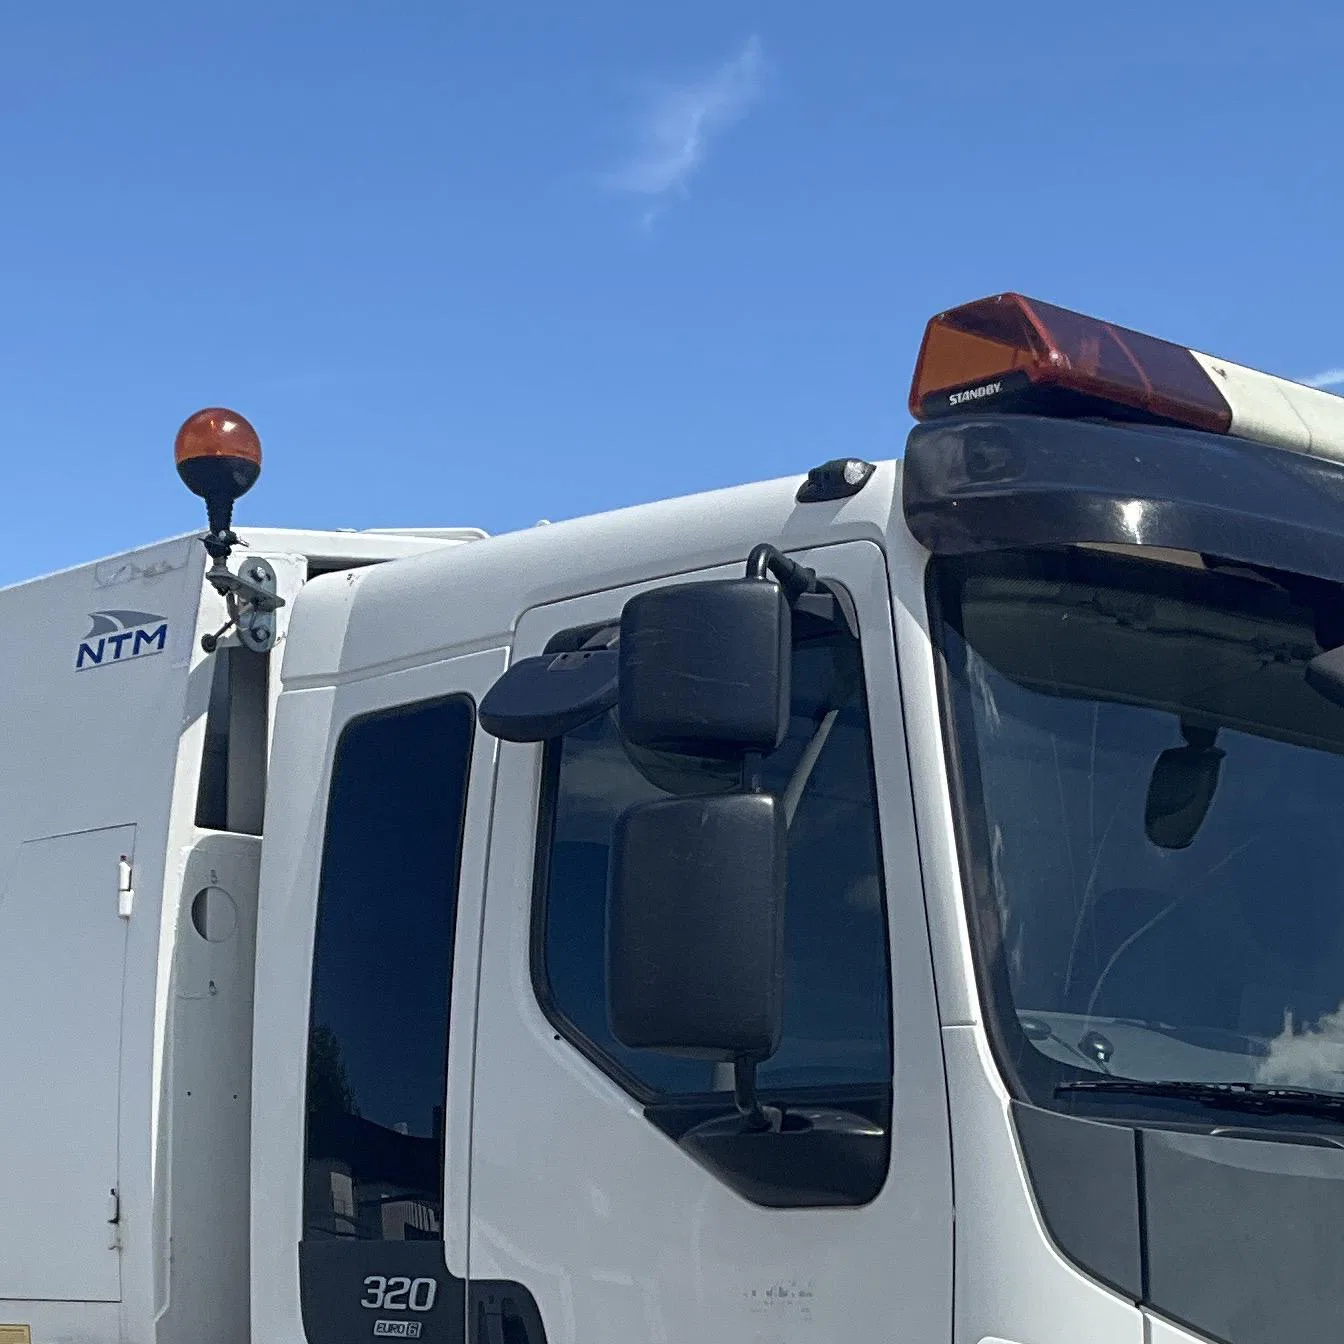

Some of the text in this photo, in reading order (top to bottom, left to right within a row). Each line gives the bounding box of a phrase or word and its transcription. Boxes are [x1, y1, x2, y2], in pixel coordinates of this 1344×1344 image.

[949, 382, 1001, 406] STANDBY
[76, 624, 167, 668] NTM
[361, 1275, 436, 1311] 320
